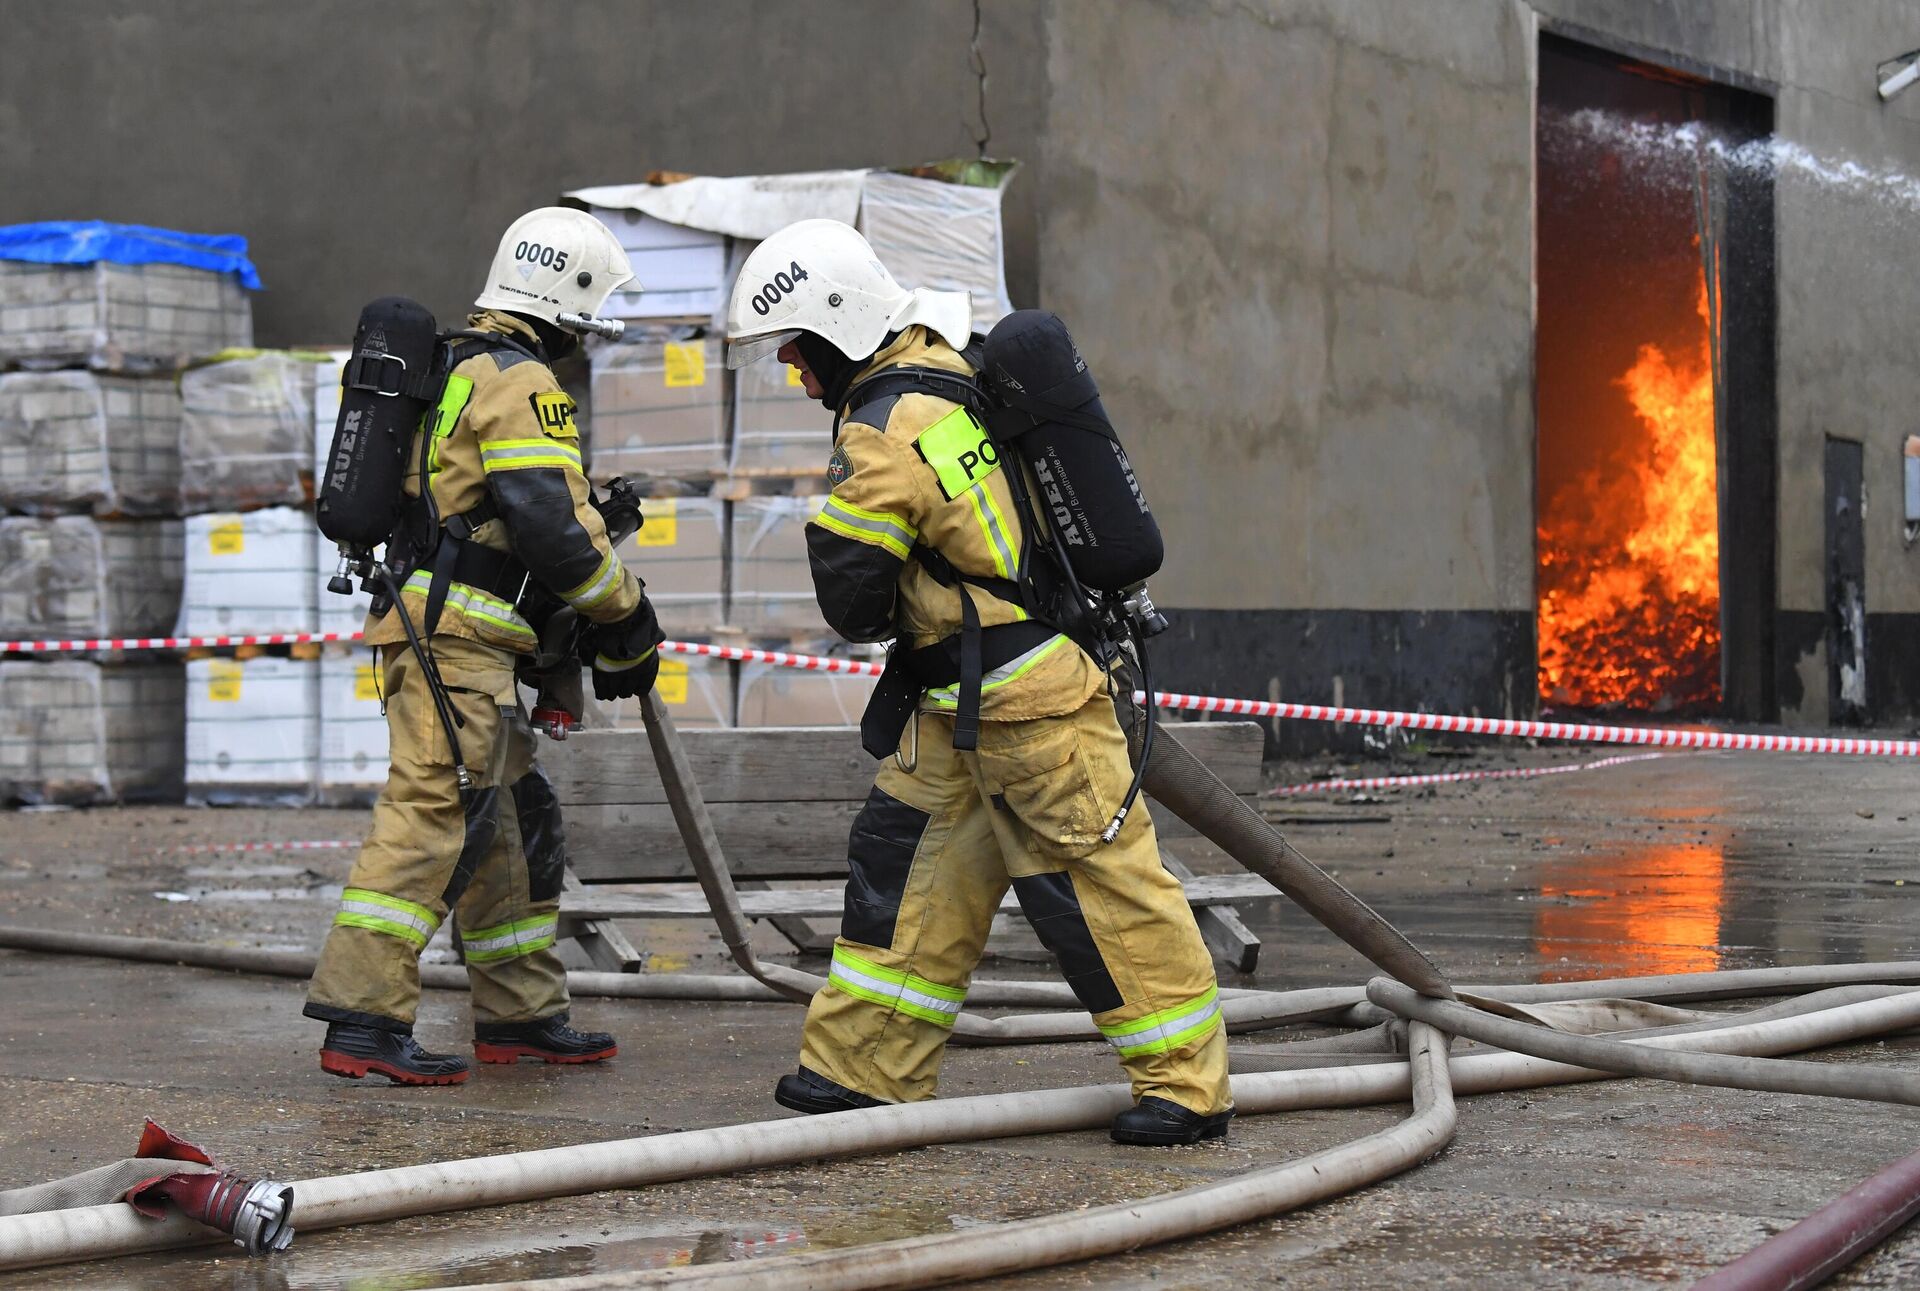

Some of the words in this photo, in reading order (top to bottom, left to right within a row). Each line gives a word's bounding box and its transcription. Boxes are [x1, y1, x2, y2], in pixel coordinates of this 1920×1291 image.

[515, 241, 569, 272] 0005
[751, 260, 809, 315] 0004
[330, 409, 362, 492] AUER
[1046, 445, 1057, 457] Air
[1034, 457, 1085, 546] AUER
[1053, 459, 1079, 507] Breathable
